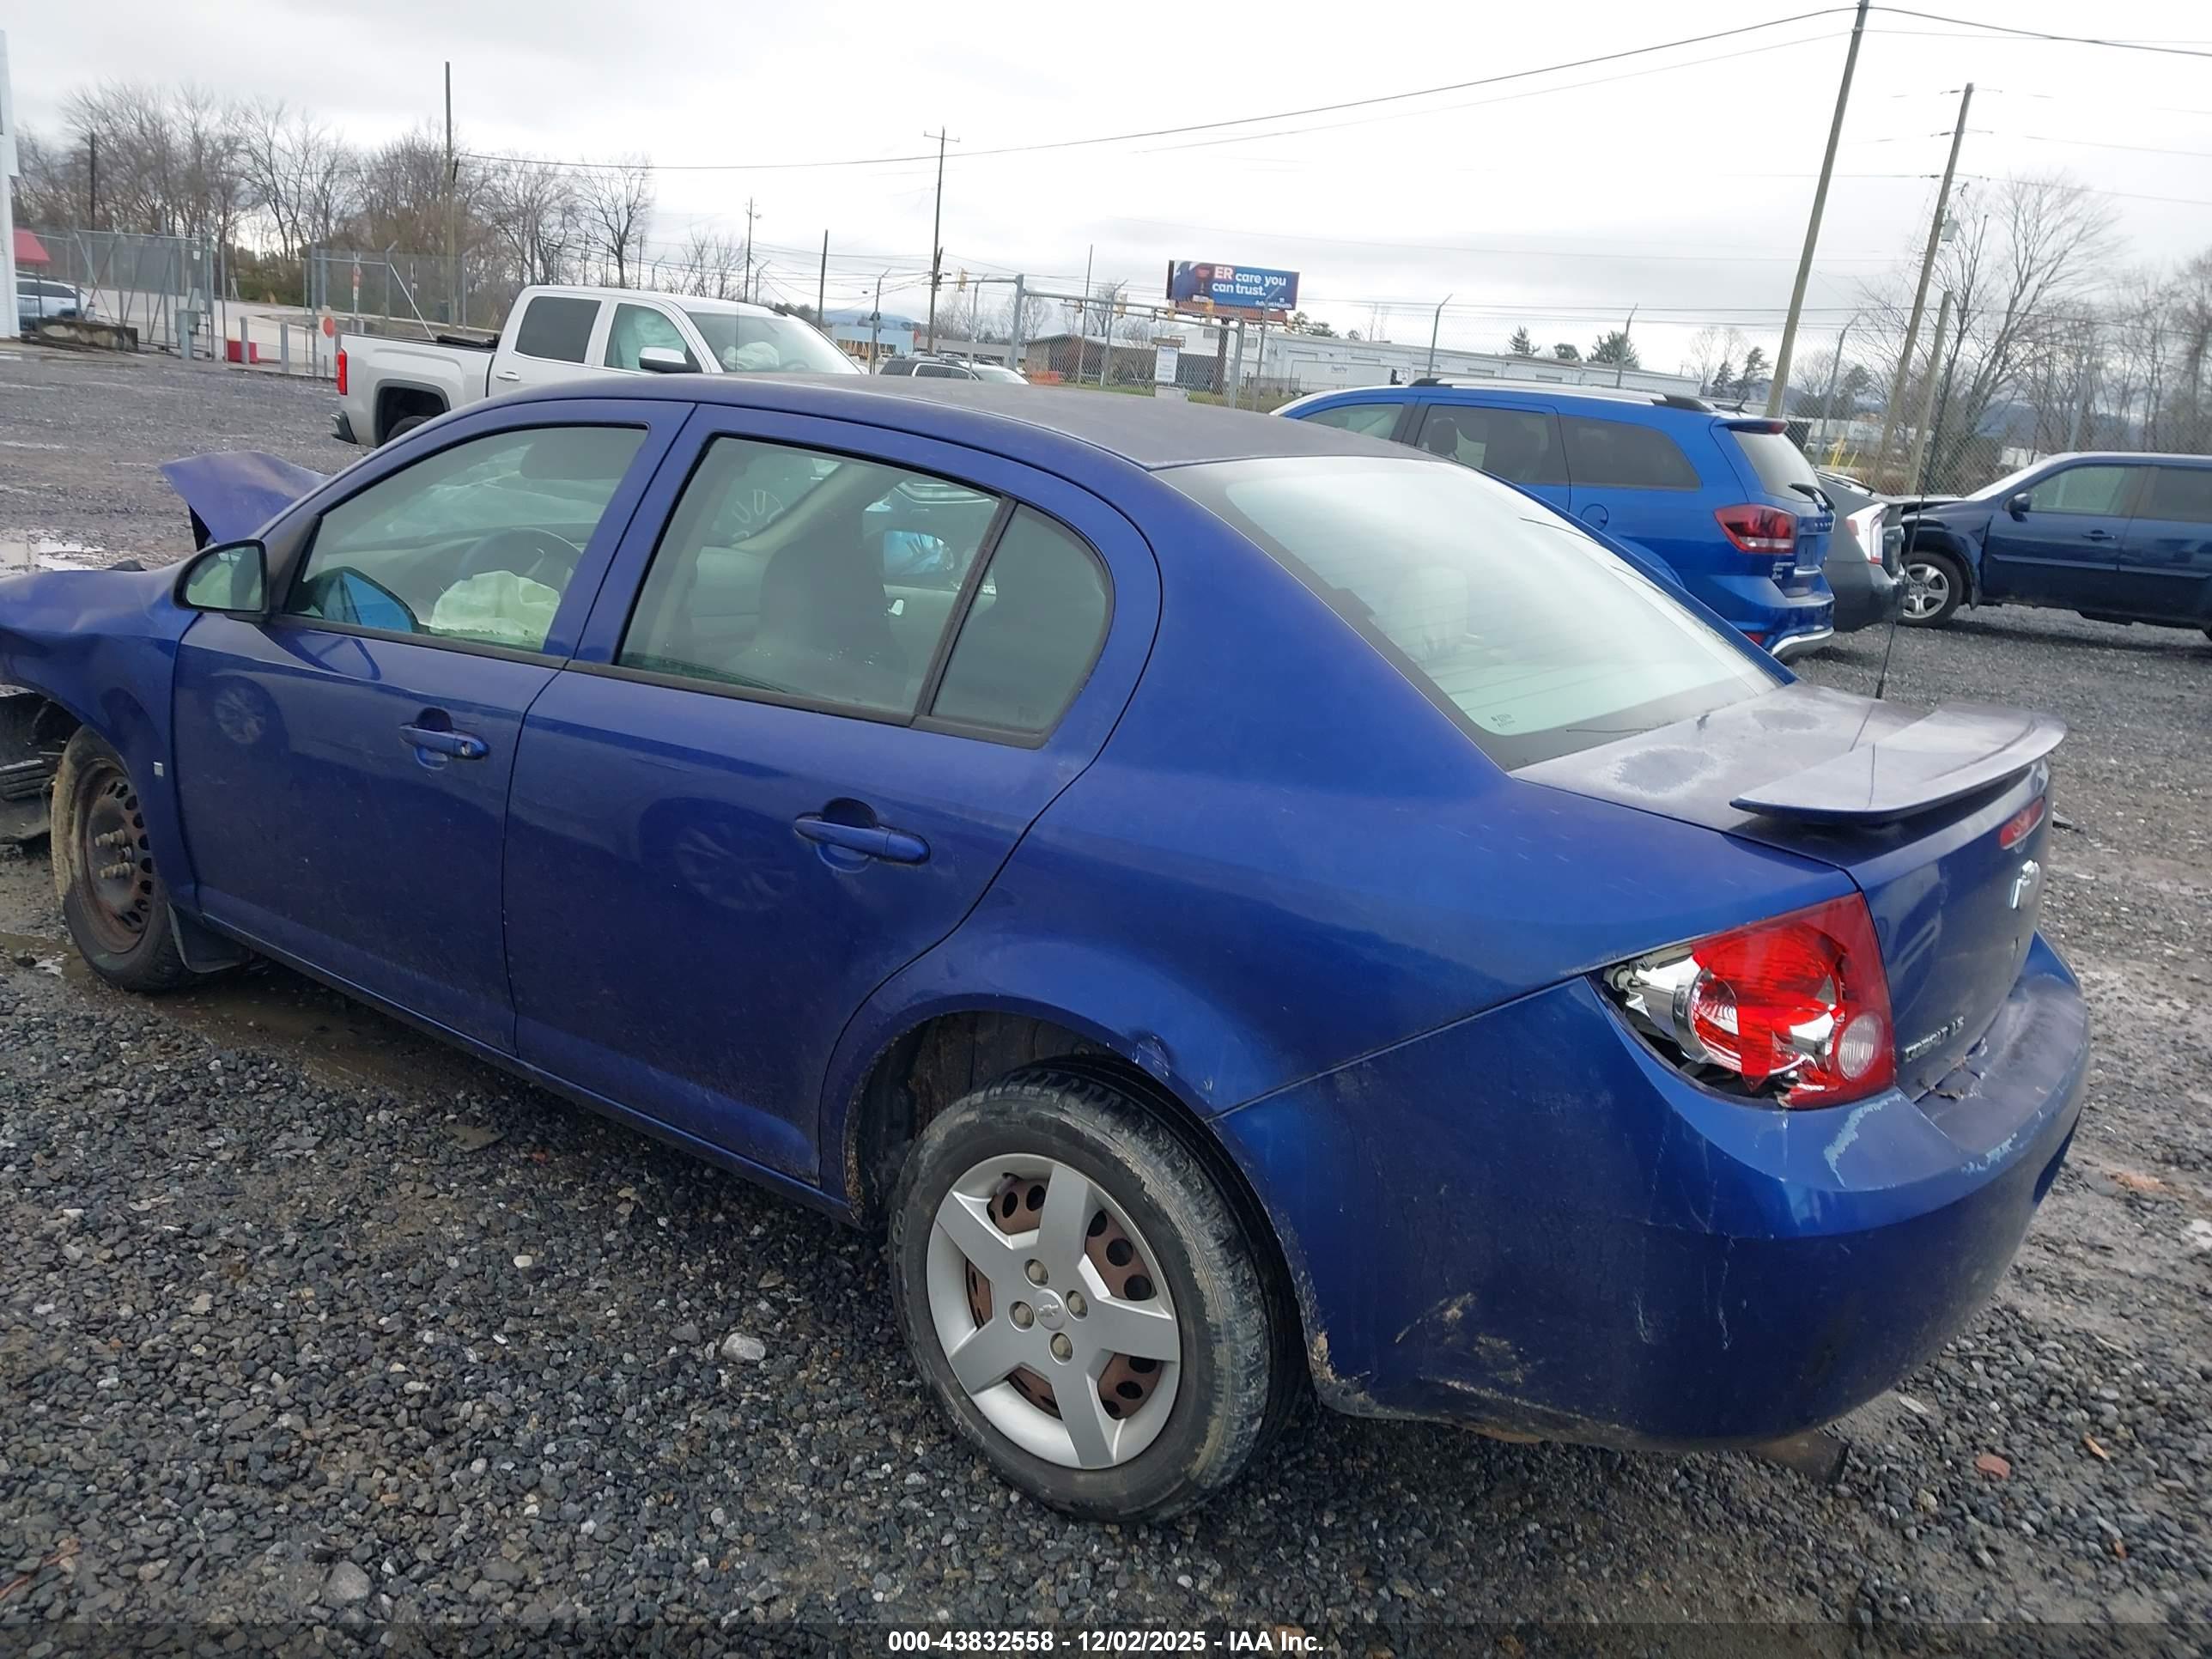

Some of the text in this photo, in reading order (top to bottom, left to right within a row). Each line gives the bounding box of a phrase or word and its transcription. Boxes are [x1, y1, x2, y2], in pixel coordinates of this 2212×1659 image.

[1214, 265, 1286, 287] ER care you
[1212, 283, 1267, 296] can trust.
